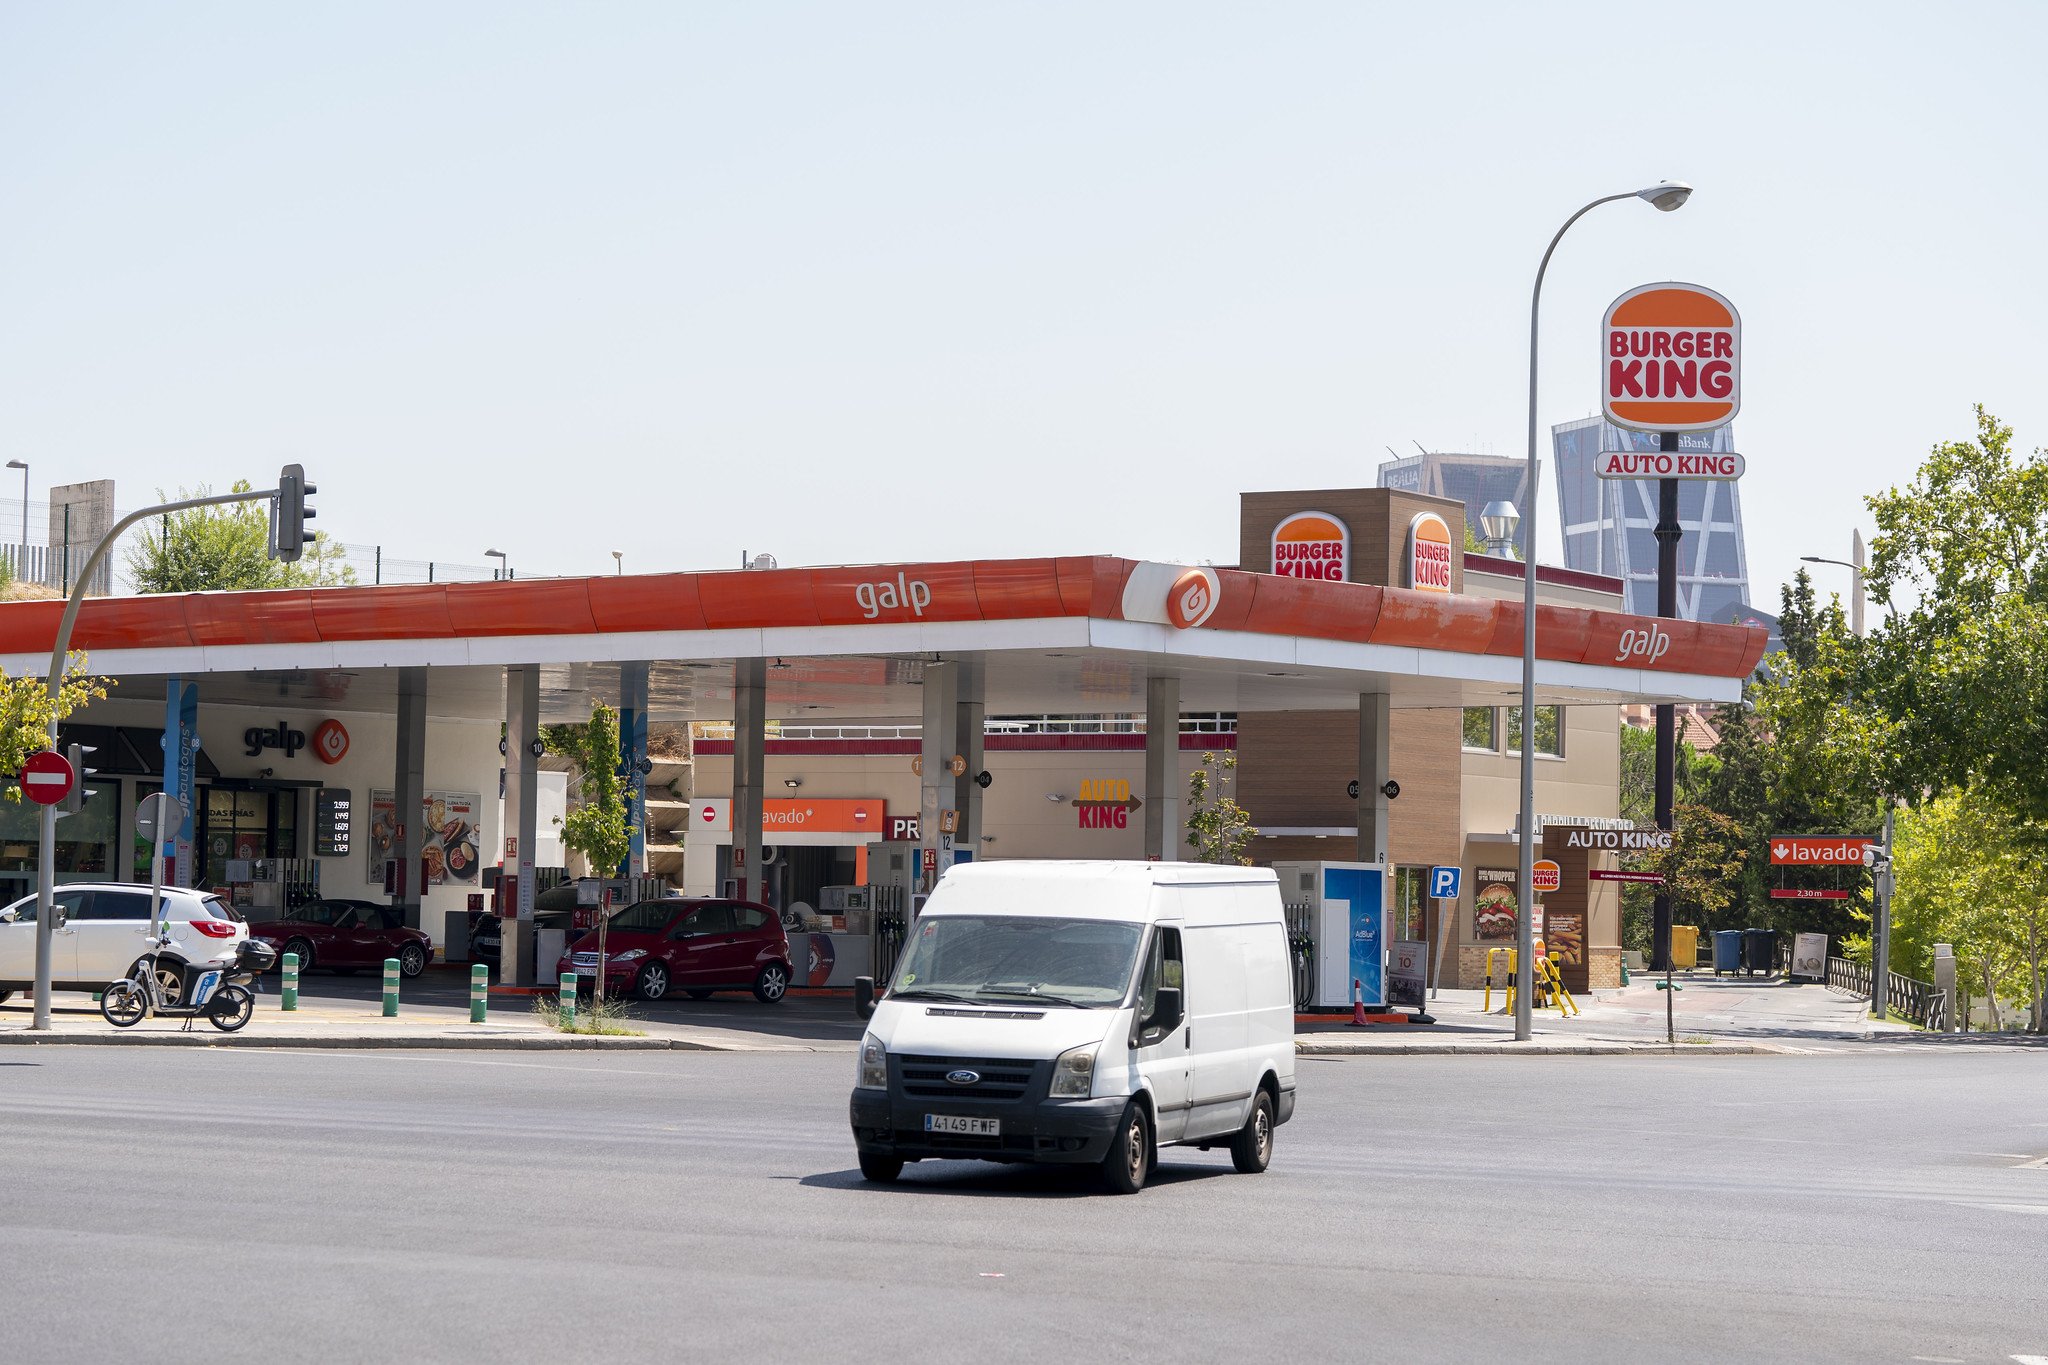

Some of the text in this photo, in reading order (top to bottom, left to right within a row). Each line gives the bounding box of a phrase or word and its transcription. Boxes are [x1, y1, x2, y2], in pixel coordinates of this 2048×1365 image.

[1610, 331, 1733, 358] BURGER
[1610, 360, 1733, 398] KING
[1650, 433, 1711, 449] CaBank
[1606, 455, 1735, 475] AUTO KING
[1276, 543, 1343, 560] BURGER
[1415, 542, 1449, 562] BURGER
[1276, 560, 1343, 581] KING
[1415, 560, 1449, 587] KING
[856, 571, 931, 619] galp
[1615, 623, 1670, 664] galp
[245, 721, 305, 758] galp
[533, 743, 543, 753] 10
[953, 760, 963, 771] 12
[1080, 778, 1129, 801] AUTO
[1386, 785, 1397, 794] 06
[762, 808, 805, 823] avado
[1079, 805, 1127, 829] KING
[894, 819, 921, 839] PR
[943, 835, 951, 850] 12
[1567, 831, 1672, 849] AUTO KING
[1792, 843, 1860, 861] lavado
[1436, 870, 1454, 894] P
[1488, 870, 1515, 882] WHOPPER
[1533, 877, 1558, 885] KING
[1797, 889, 1814, 898] 2,30
[1399, 957, 1412, 968] 10
[952, 1073, 972, 1081] Ford
[934, 1117, 996, 1133] 4149 FWF
